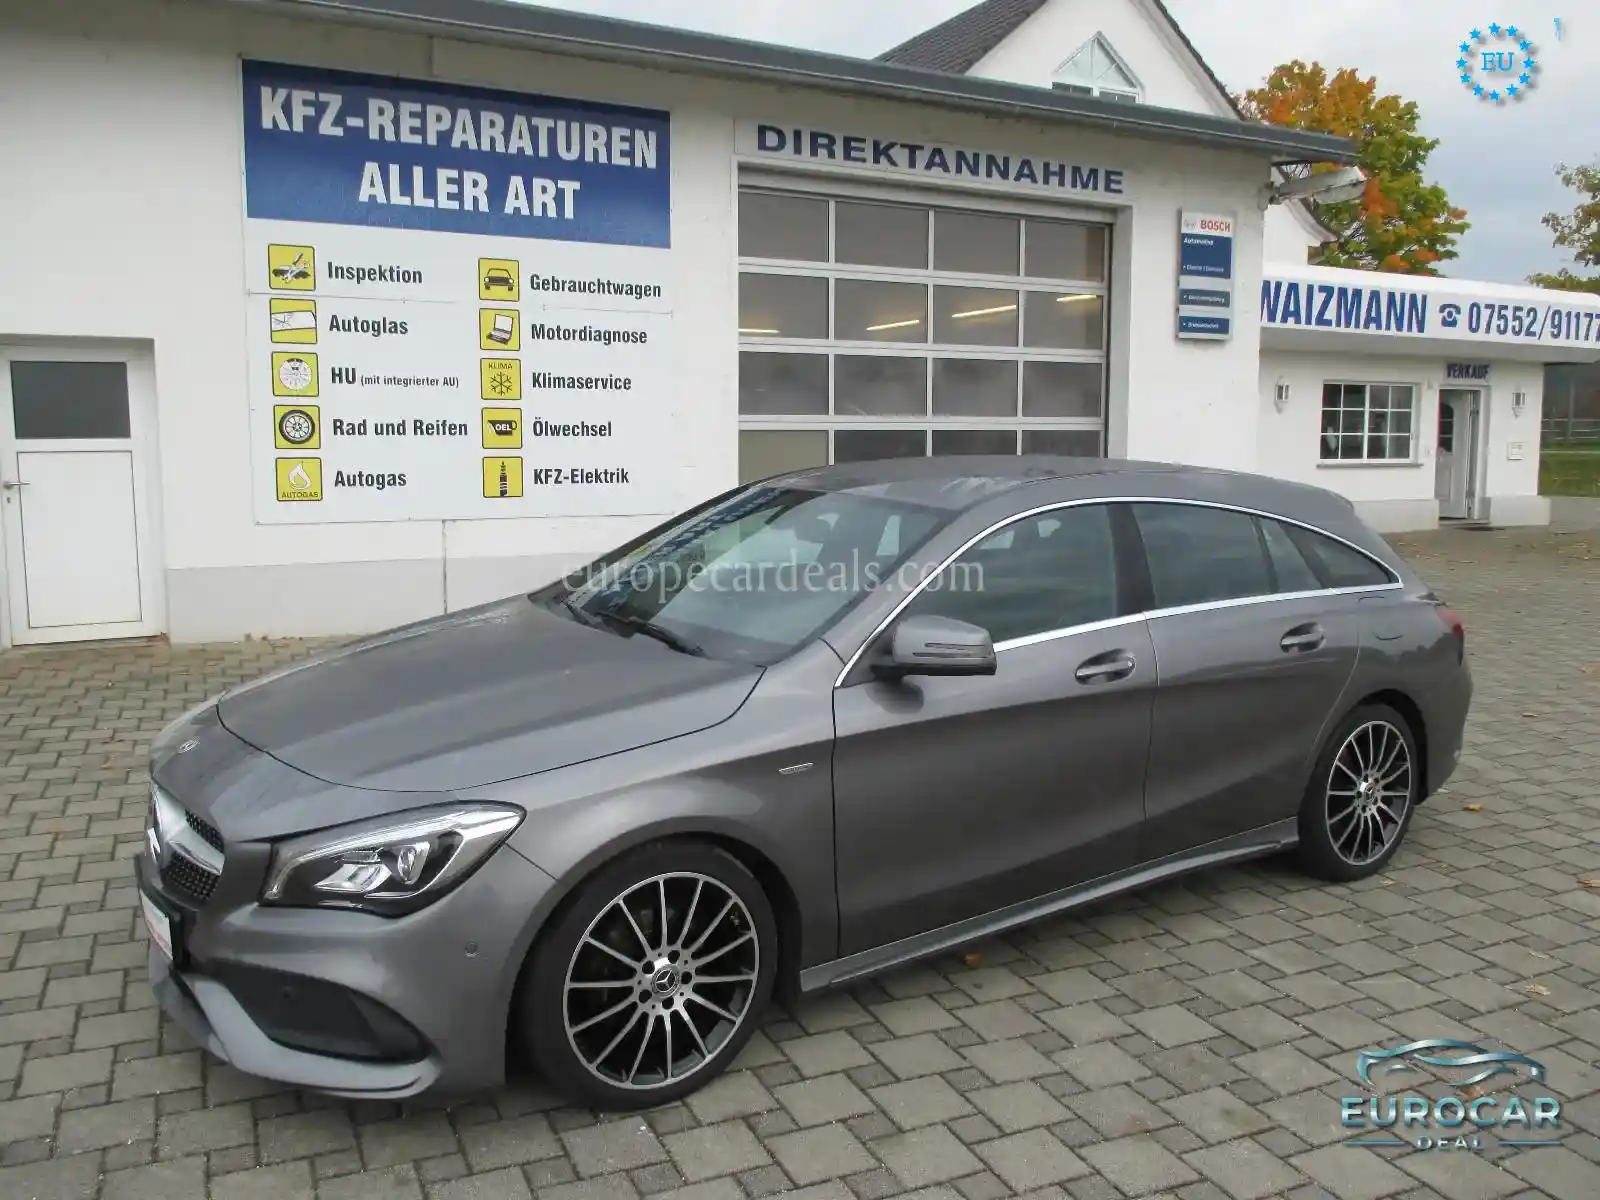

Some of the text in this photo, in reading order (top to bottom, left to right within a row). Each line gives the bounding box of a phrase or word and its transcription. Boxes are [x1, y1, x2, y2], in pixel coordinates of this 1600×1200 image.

[260, 85, 658, 170] KFZ-REPARATUREN
[757, 123, 1124, 194] DIREKTANNAHME
[358, 160, 581, 219] ALLER ART
[1200, 219, 1231, 233] BOSCH
[327, 261, 423, 284] Inspektion
[529, 274, 662, 300] Gebrauchtwagen
[328, 314, 409, 337] Autoglas
[531, 323, 648, 346] Motordiagnose
[488, 362, 513, 371] KLIMA
[1446, 363, 1490, 379] VERKAUF
[331, 366, 460, 389] HU (mit integrierter AU)
[532, 372, 632, 390] Klimaservice
[333, 418, 468, 437] Rad und Reifen
[495, 423, 512, 432] OEL
[532, 416, 612, 437] Ölwechsel
[334, 470, 407, 490] Autogas
[533, 467, 630, 485] KFZ-Elektrik
[281, 490, 319, 500] AUTOGAS
